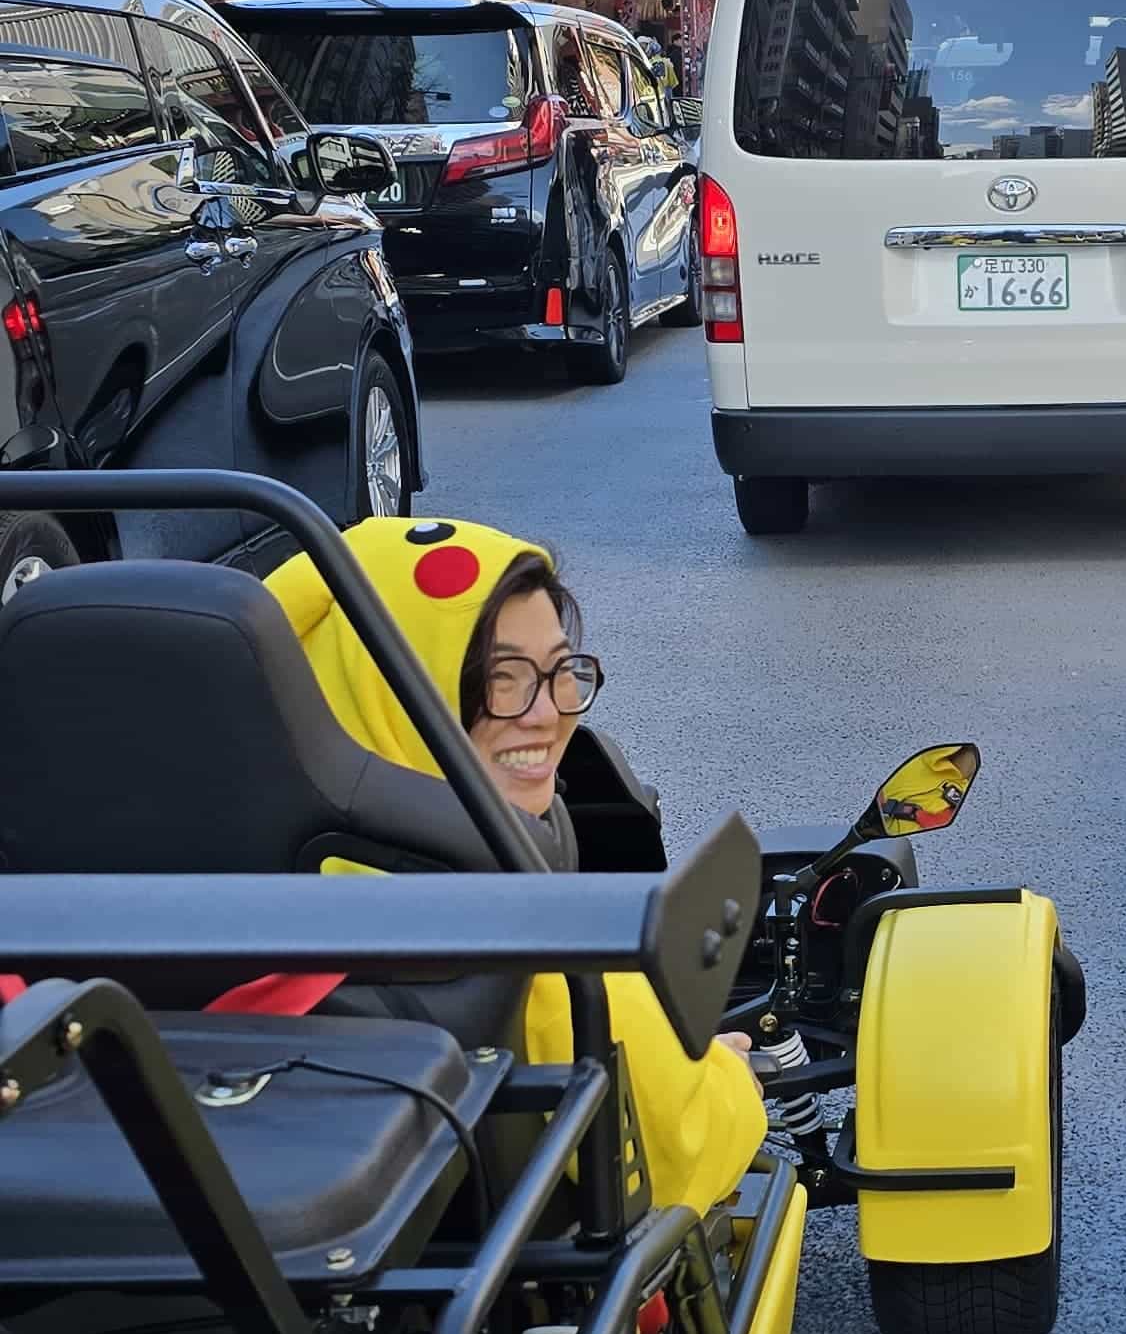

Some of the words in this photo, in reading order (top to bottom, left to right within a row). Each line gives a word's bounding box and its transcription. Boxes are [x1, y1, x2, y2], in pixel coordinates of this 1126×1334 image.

[984, 258, 1015, 274] 足立
[1018, 258, 1045, 274] 330
[964, 285, 979, 299] か
[987, 276, 1063, 306] 16-66
